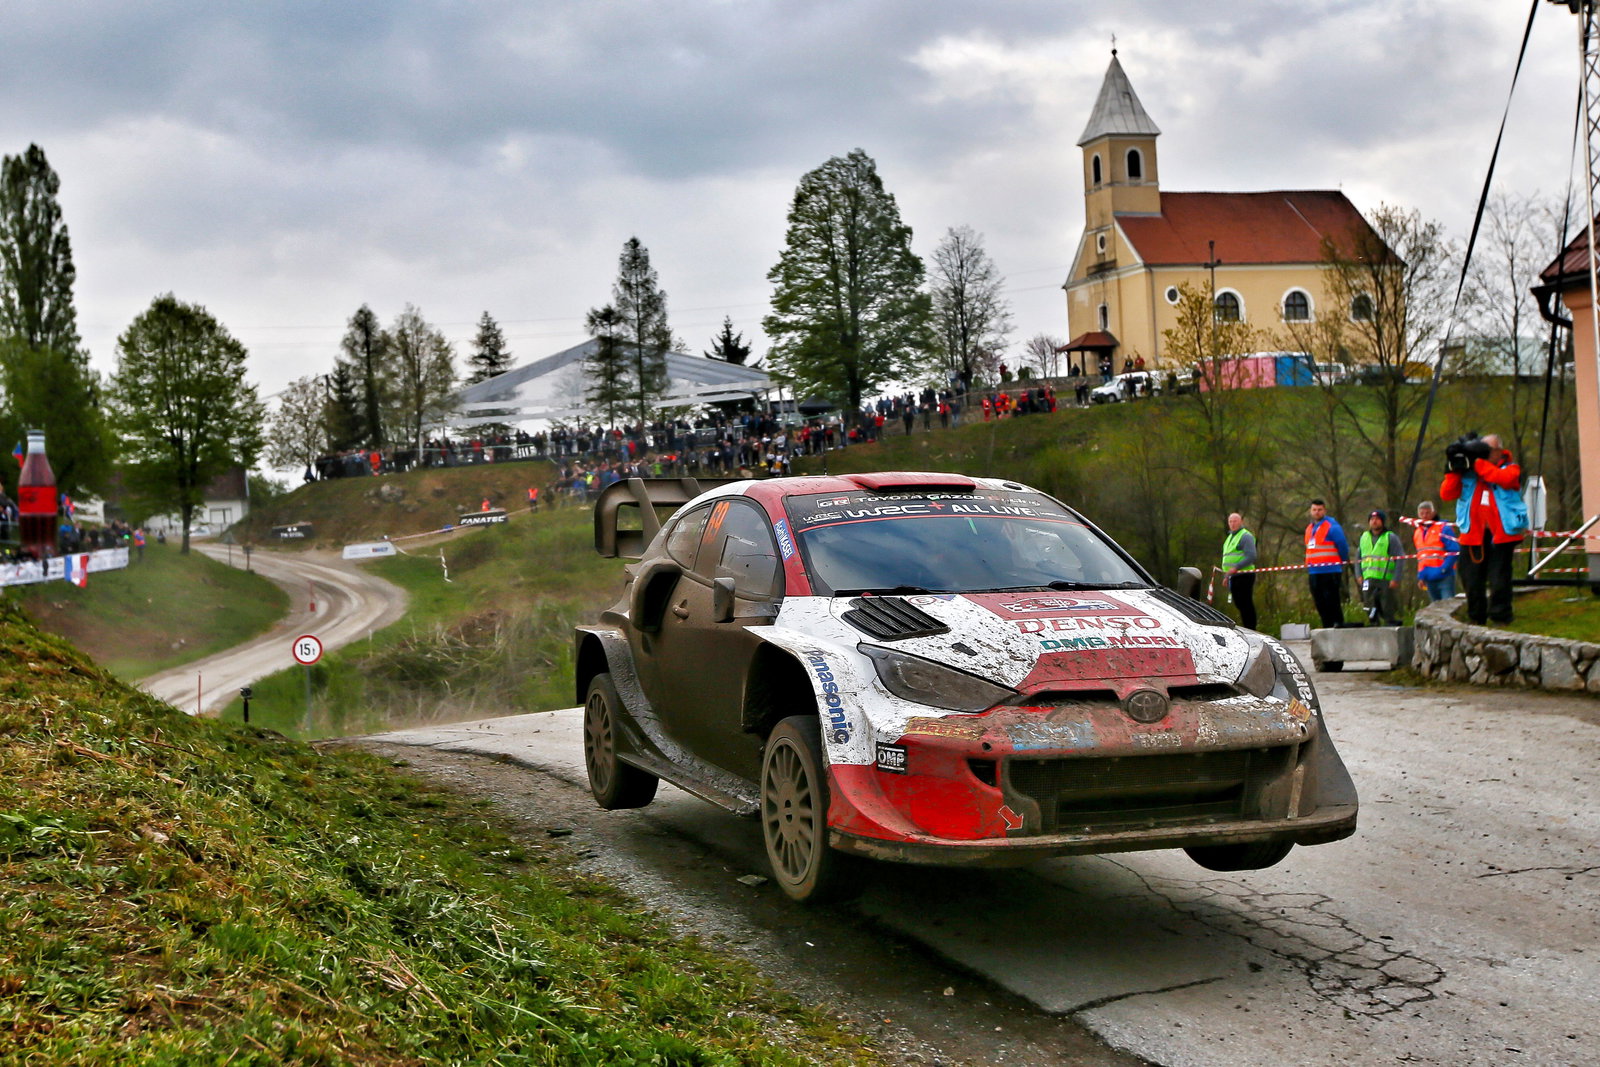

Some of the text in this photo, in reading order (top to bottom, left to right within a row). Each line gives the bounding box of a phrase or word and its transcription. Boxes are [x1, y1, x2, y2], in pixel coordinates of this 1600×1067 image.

[819, 498, 849, 507] GR
[951, 504, 990, 514] ALL
[990, 505, 1036, 517] LIVE
[460, 516, 506, 525] FANATEC
[1015, 616, 1162, 635] DENSO
[300, 643, 311, 656] 15
[1039, 636, 1180, 650] DMG MORI
[878, 750, 905, 767] OMP
